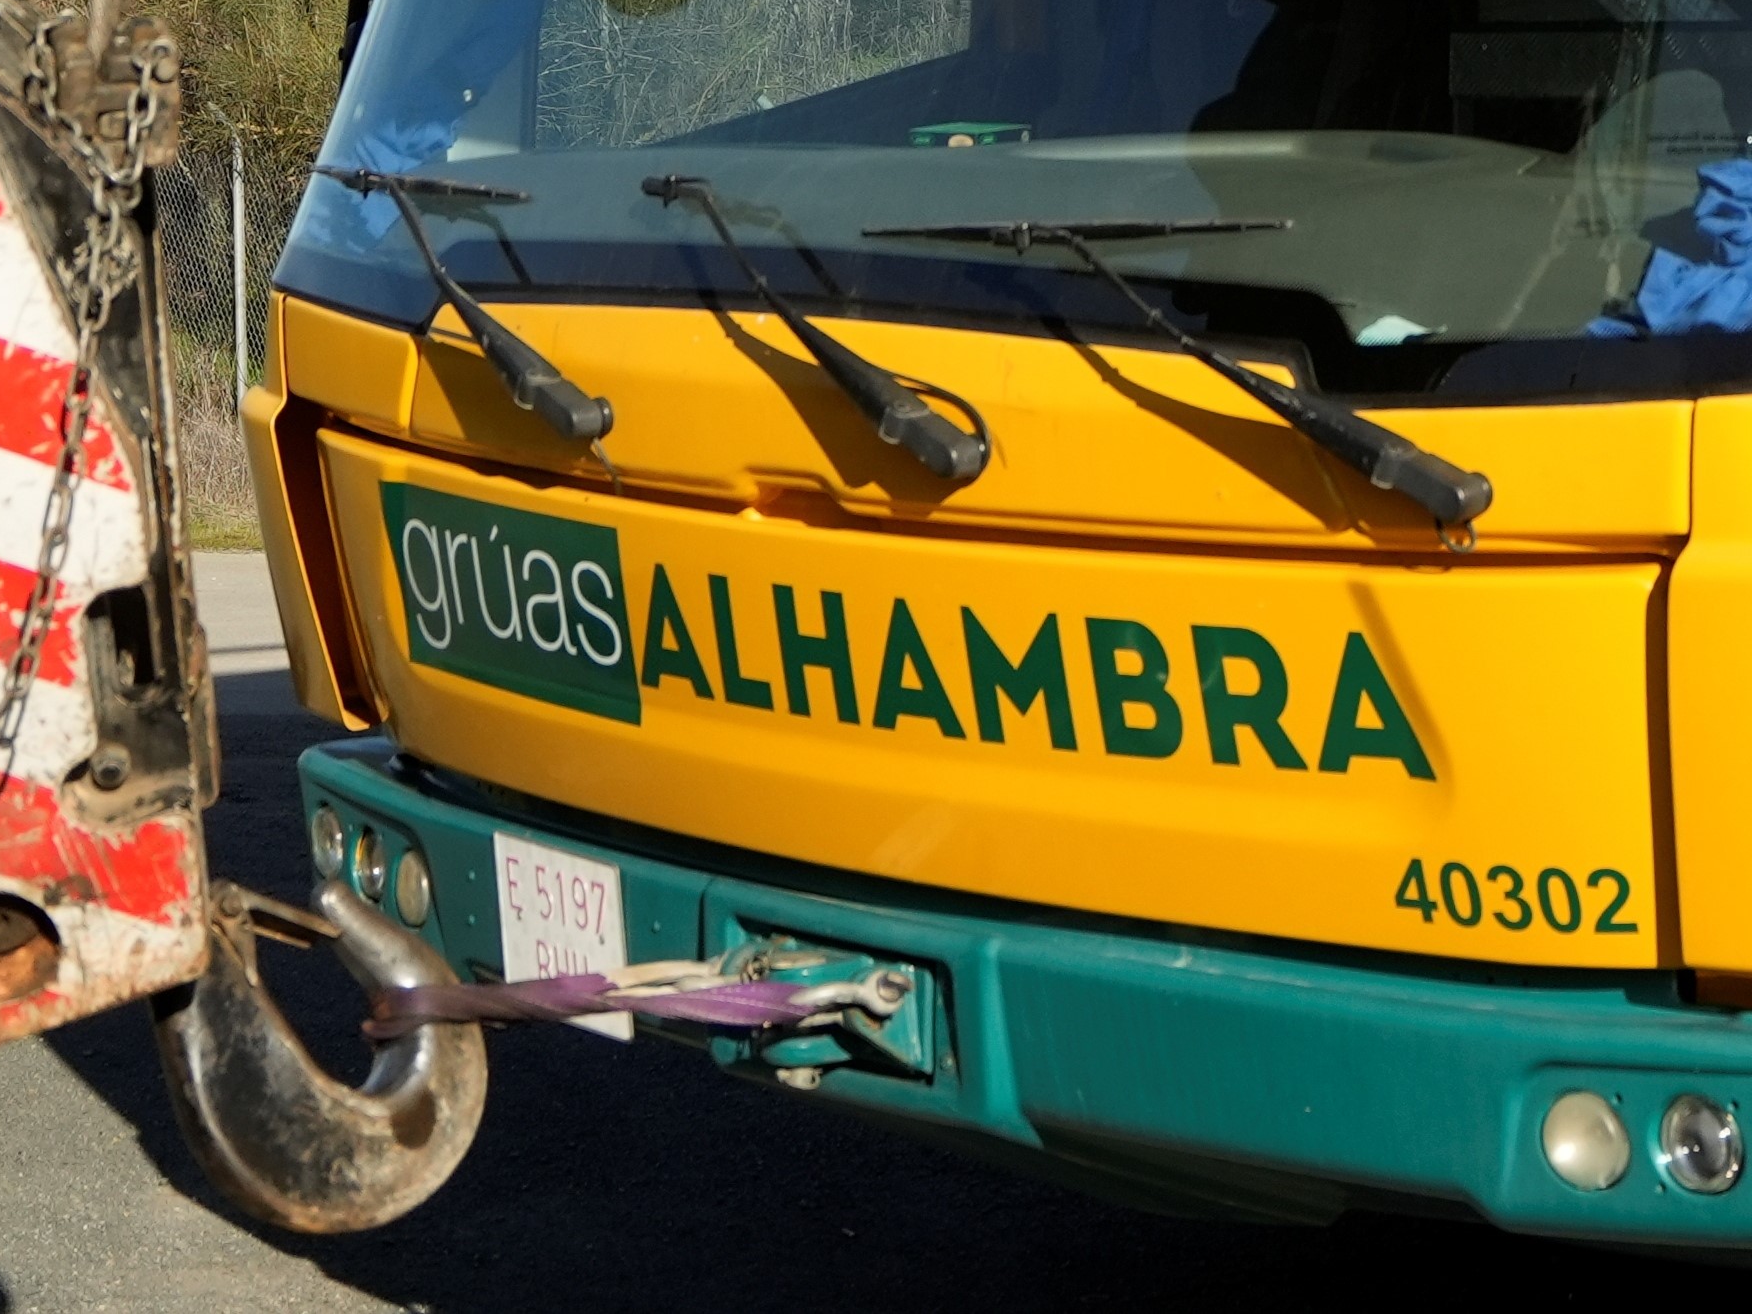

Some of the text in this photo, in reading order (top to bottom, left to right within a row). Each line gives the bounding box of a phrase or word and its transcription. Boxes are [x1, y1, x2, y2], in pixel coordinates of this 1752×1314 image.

[403, 518, 622, 666] grúas
[641, 562, 1438, 782] ALHAMBRA
[506, 856, 605, 935] E 5197
[1395, 858, 1639, 934] 40302
